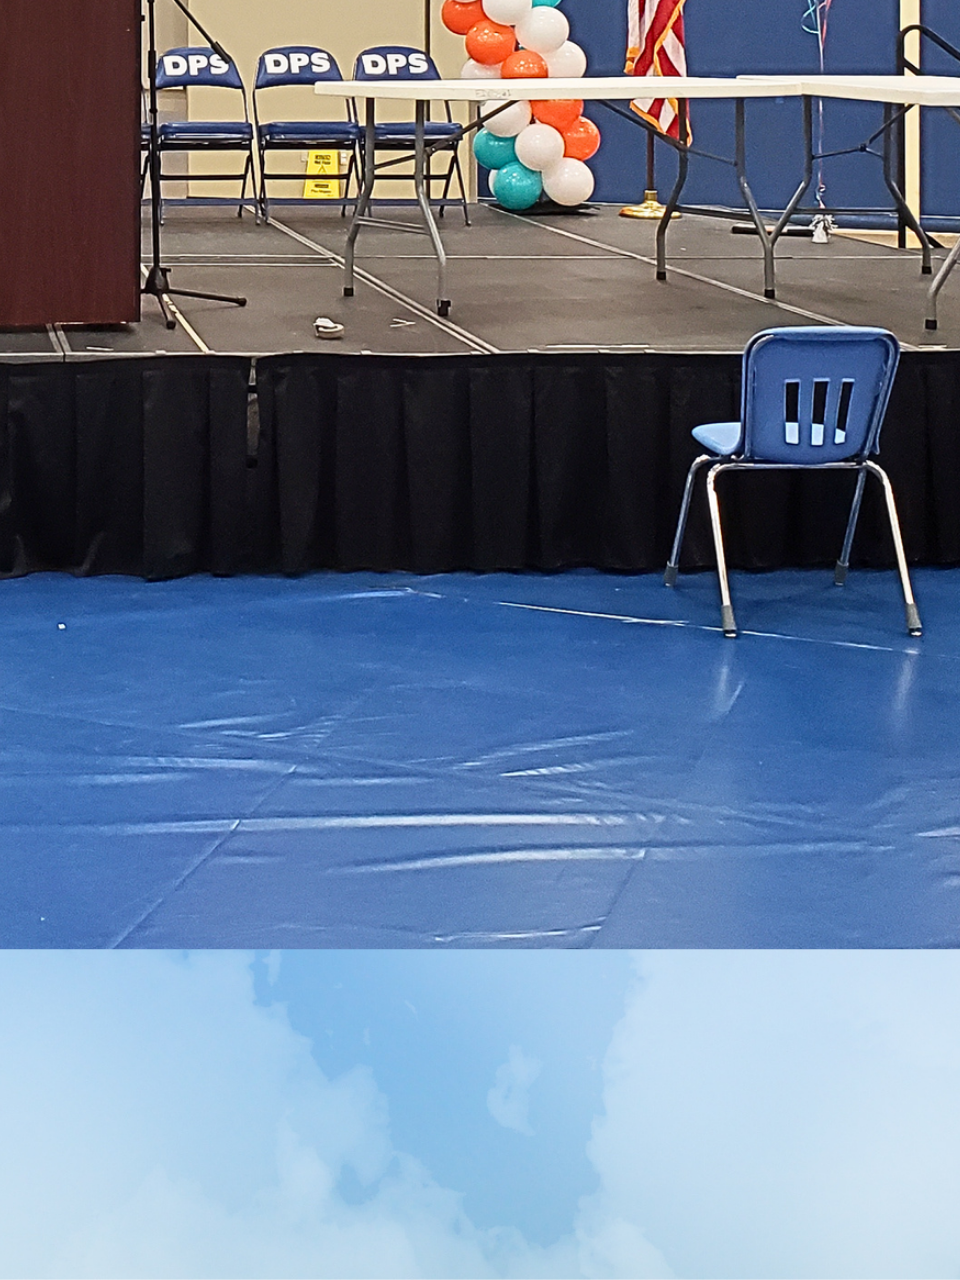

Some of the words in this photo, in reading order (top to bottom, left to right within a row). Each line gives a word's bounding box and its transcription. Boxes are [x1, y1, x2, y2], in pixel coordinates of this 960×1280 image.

[162, 54, 229, 76] DPS
[263, 52, 331, 74] DPS
[362, 53, 428, 75] DPS
